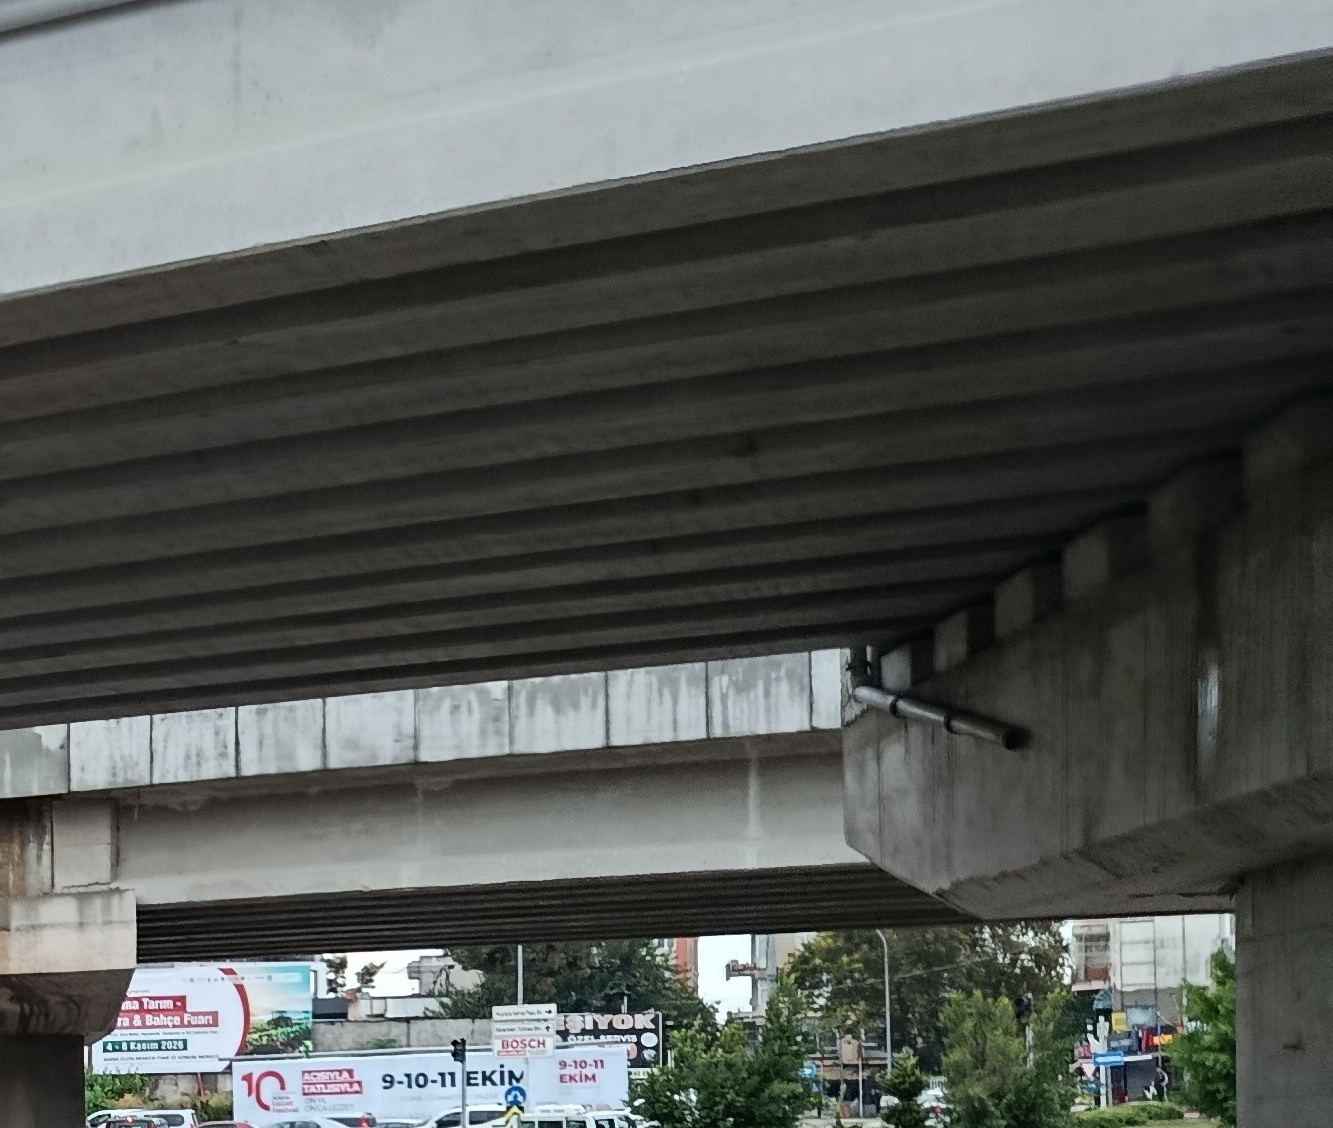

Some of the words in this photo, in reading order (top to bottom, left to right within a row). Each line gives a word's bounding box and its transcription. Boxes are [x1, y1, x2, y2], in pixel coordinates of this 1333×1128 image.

[117, 1016, 130, 1027] ra
[133, 1013, 142, 1026] &
[145, 1013, 180, 1028] Bahçe
[501, 1039, 546, 1049] BOSCH
[559, 1059, 605, 1070] 9-10-11
[381, 1072, 456, 1089] 9-10-11
[466, 1064, 524, 1087] EKİM
[559, 1071, 597, 1083] EKİM
